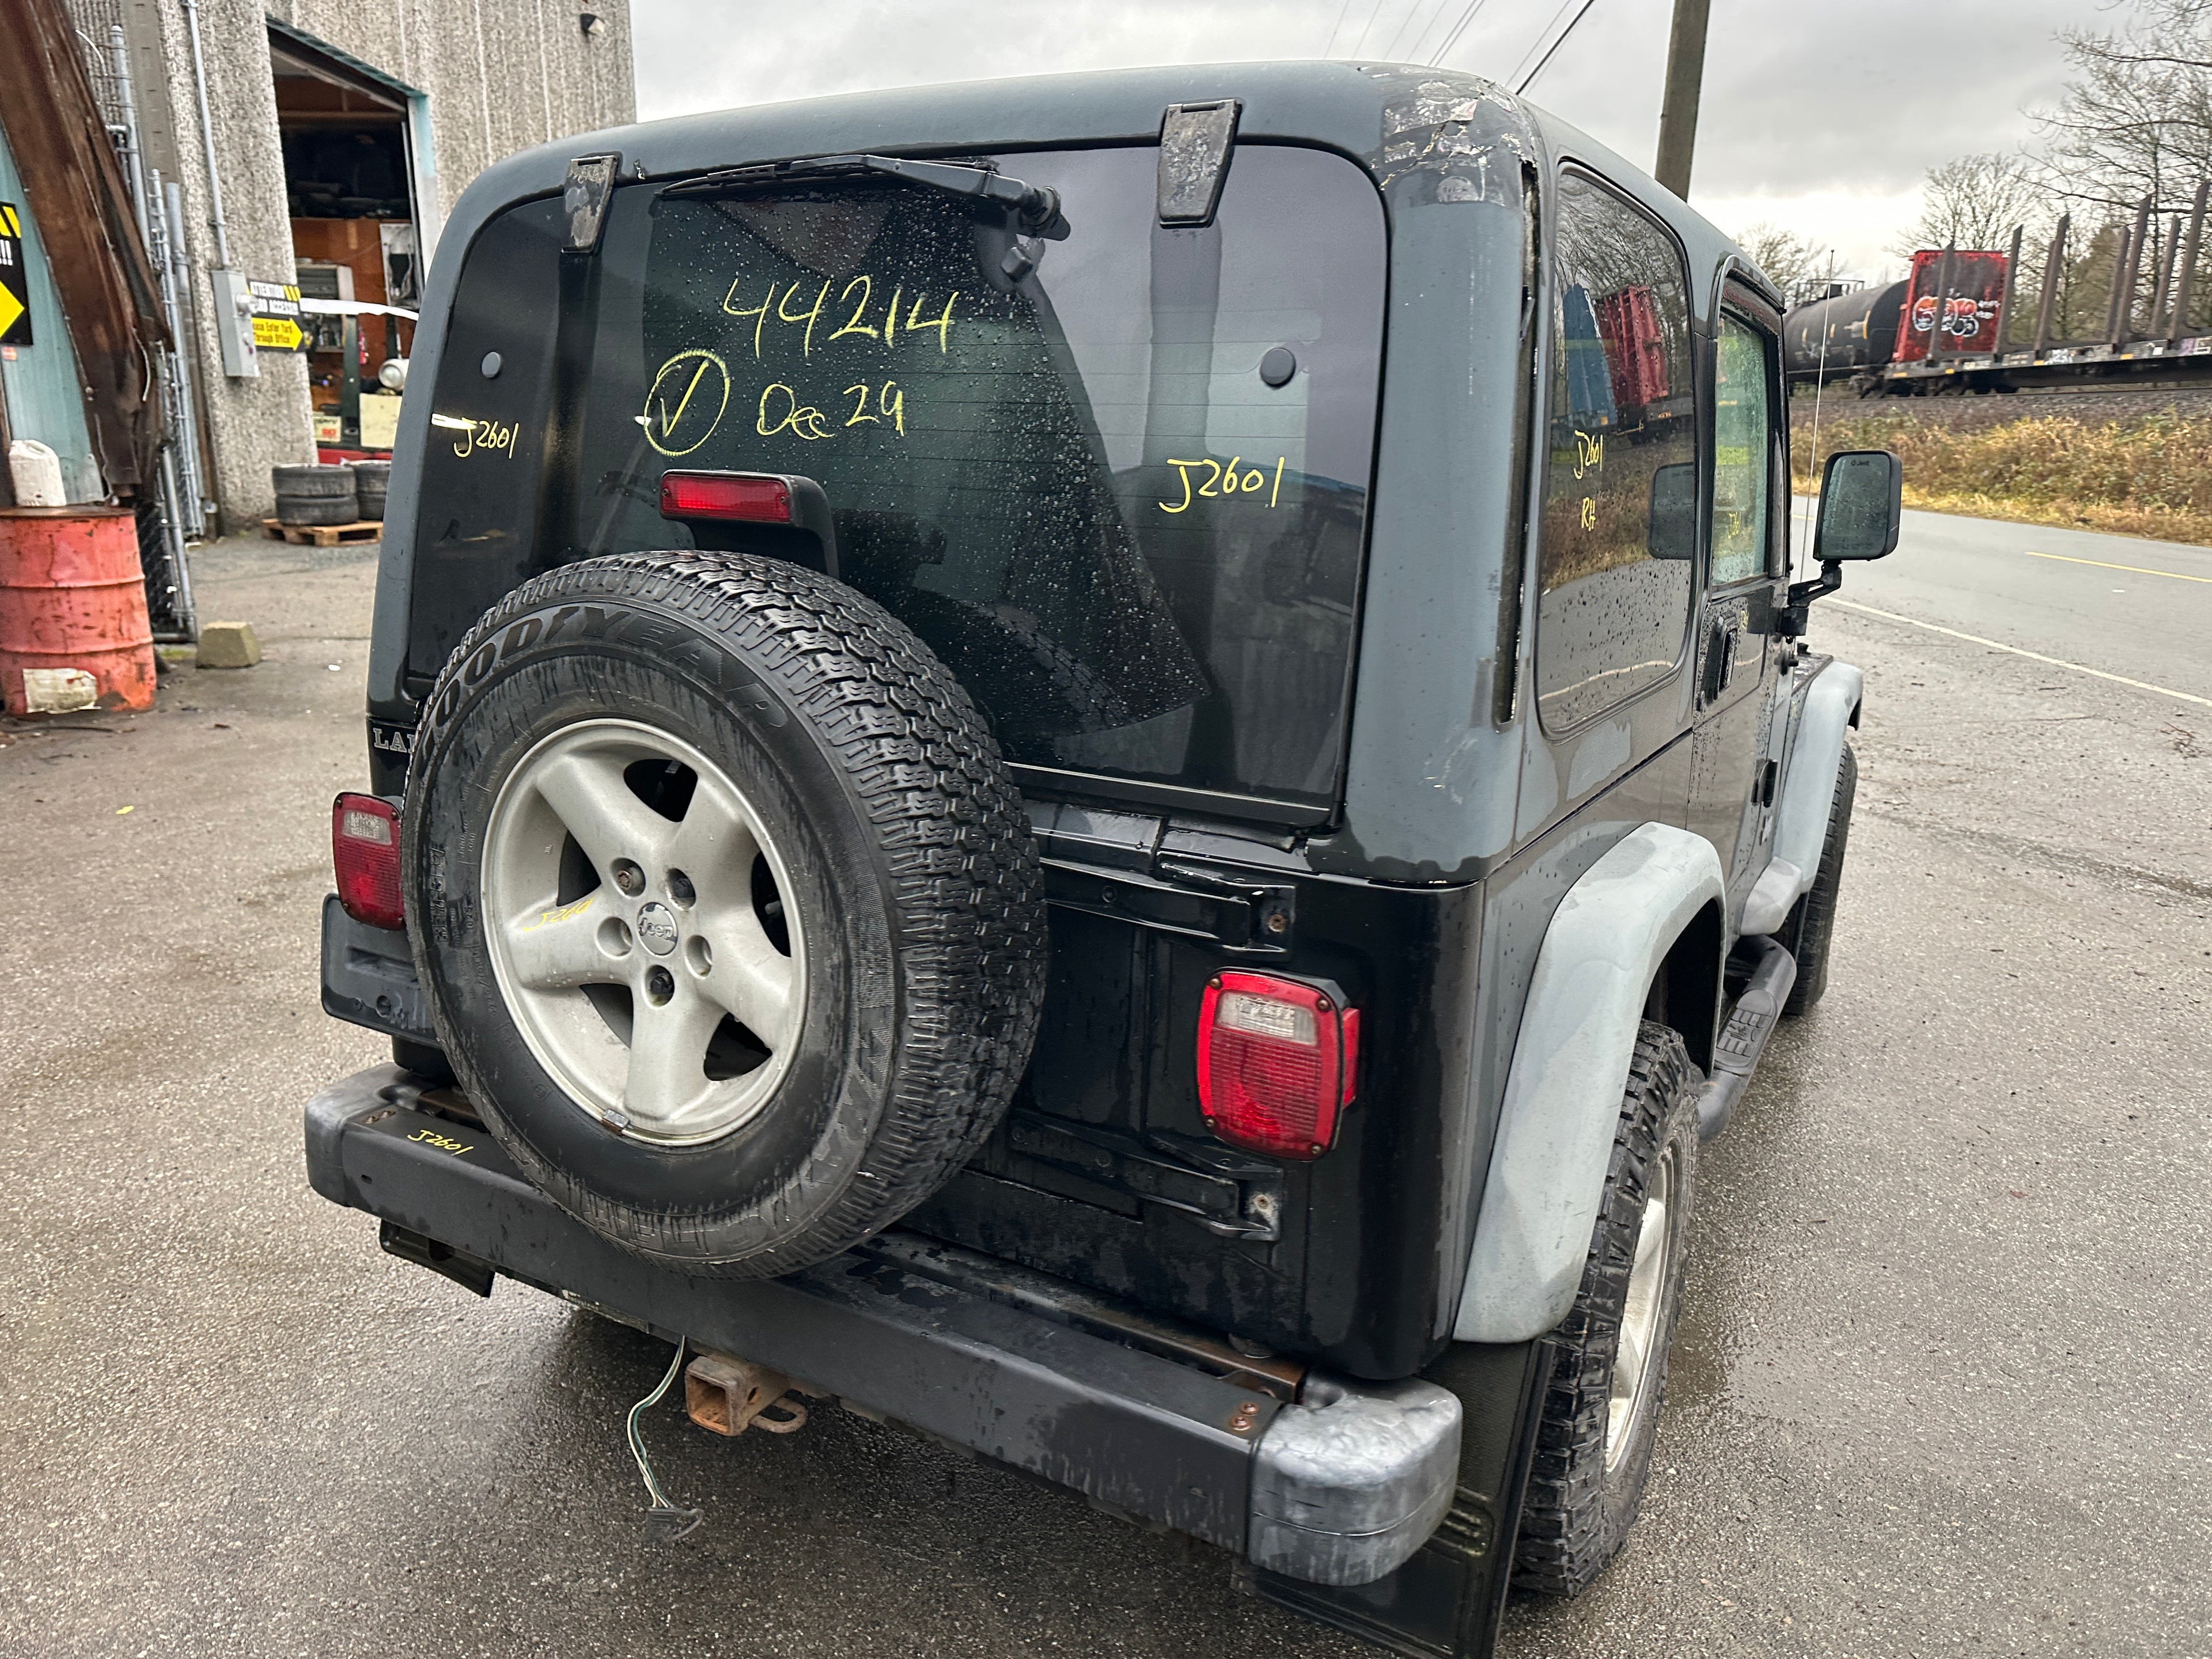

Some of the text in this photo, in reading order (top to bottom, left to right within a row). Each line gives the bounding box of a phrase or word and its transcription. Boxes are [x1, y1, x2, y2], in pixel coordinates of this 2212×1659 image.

[722, 275, 960, 358] 44214
[843, 380, 905, 437] 29
[453, 416, 520, 460] J2601
[1158, 456, 1286, 513] J2601
[638, 916, 673, 941] Jeep
[407, 1129, 474, 1157] J2601
